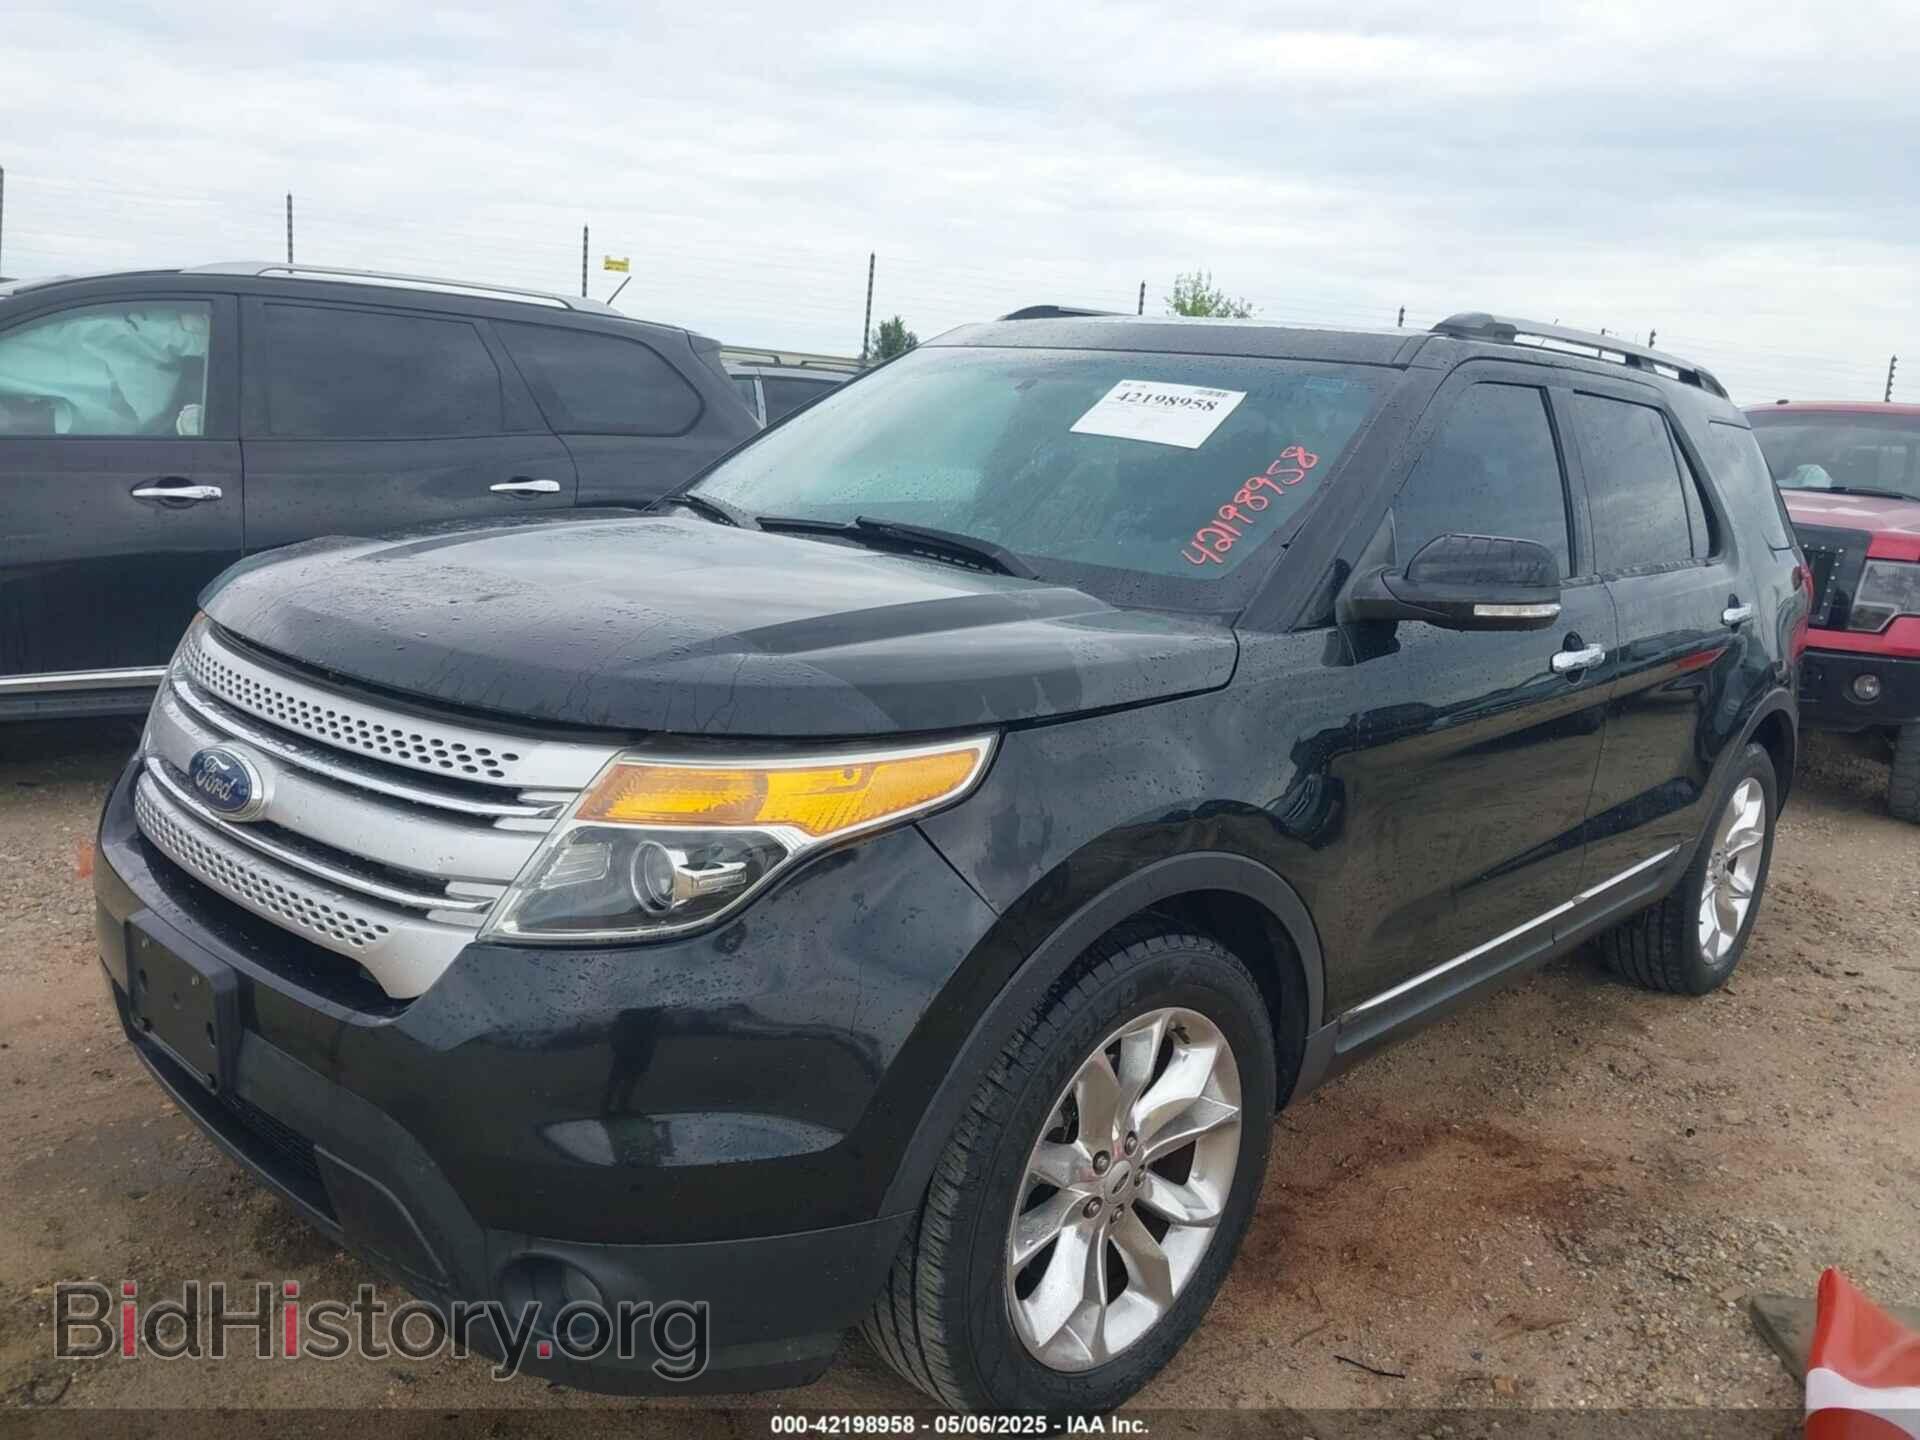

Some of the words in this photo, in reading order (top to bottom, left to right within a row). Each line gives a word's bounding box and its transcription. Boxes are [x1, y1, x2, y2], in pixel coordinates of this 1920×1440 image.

[1115, 391, 1219, 412] 42198958
[1181, 446, 1318, 565] 42198958
[195, 755, 238, 801] Ford
